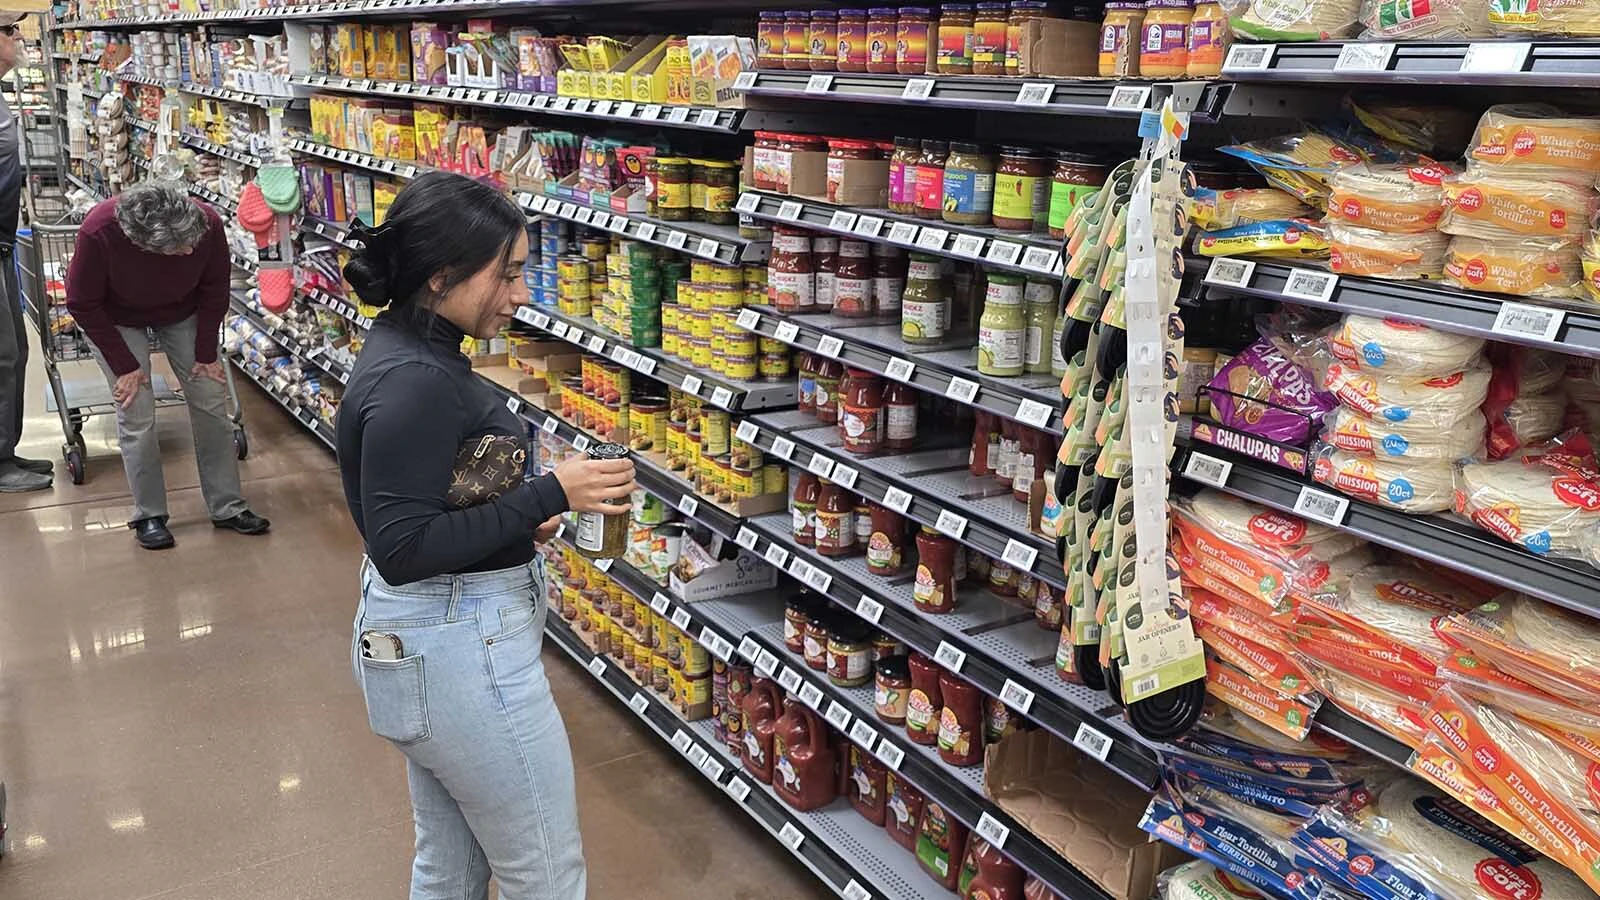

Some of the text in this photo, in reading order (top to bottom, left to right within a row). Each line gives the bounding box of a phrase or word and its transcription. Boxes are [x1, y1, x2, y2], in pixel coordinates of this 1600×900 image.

[1540, 136, 1574, 147] White
[1547, 147, 1593, 161] Tortillas
[1459, 198, 1479, 208] soft
[1486, 195, 1545, 219] White Corn
[1492, 206, 1536, 226] Tortillas
[1331, 254, 1342, 265] oft
[1465, 270, 1484, 279] soft
[1340, 385, 1376, 413] mission
[1216, 429, 1281, 463] CHALUPAS
[1336, 435, 1373, 449] mission
[1338, 474, 1378, 493] mission
[1390, 483, 1411, 499] 20ct
[1254, 517, 1295, 541] soft
[1268, 512, 1297, 530] super
[1196, 537, 1256, 578] Flour Tortillas
[1137, 634, 1150, 644] JAR
[1151, 623, 1182, 640] OPENERS
[1212, 626, 1240, 648] Flour
[1238, 641, 1278, 672] Tortillas
[1217, 673, 1280, 712] Flour Tortillas
[1431, 714, 1469, 751] mission
[1474, 750, 1496, 771] soft
[1420, 759, 1465, 793] mission
[1429, 805, 1467, 828] Flour
[1505, 772, 1540, 809] Flour
[1538, 801, 1590, 855] Tortillas
[1508, 795, 1540, 827] SOFT
[1213, 826, 1279, 869] Flour Tortillas
[1217, 842, 1256, 868] BURRITO
[1385, 874, 1417, 898] Flour
[1482, 864, 1529, 900] soft
[1498, 863, 1533, 889] super
